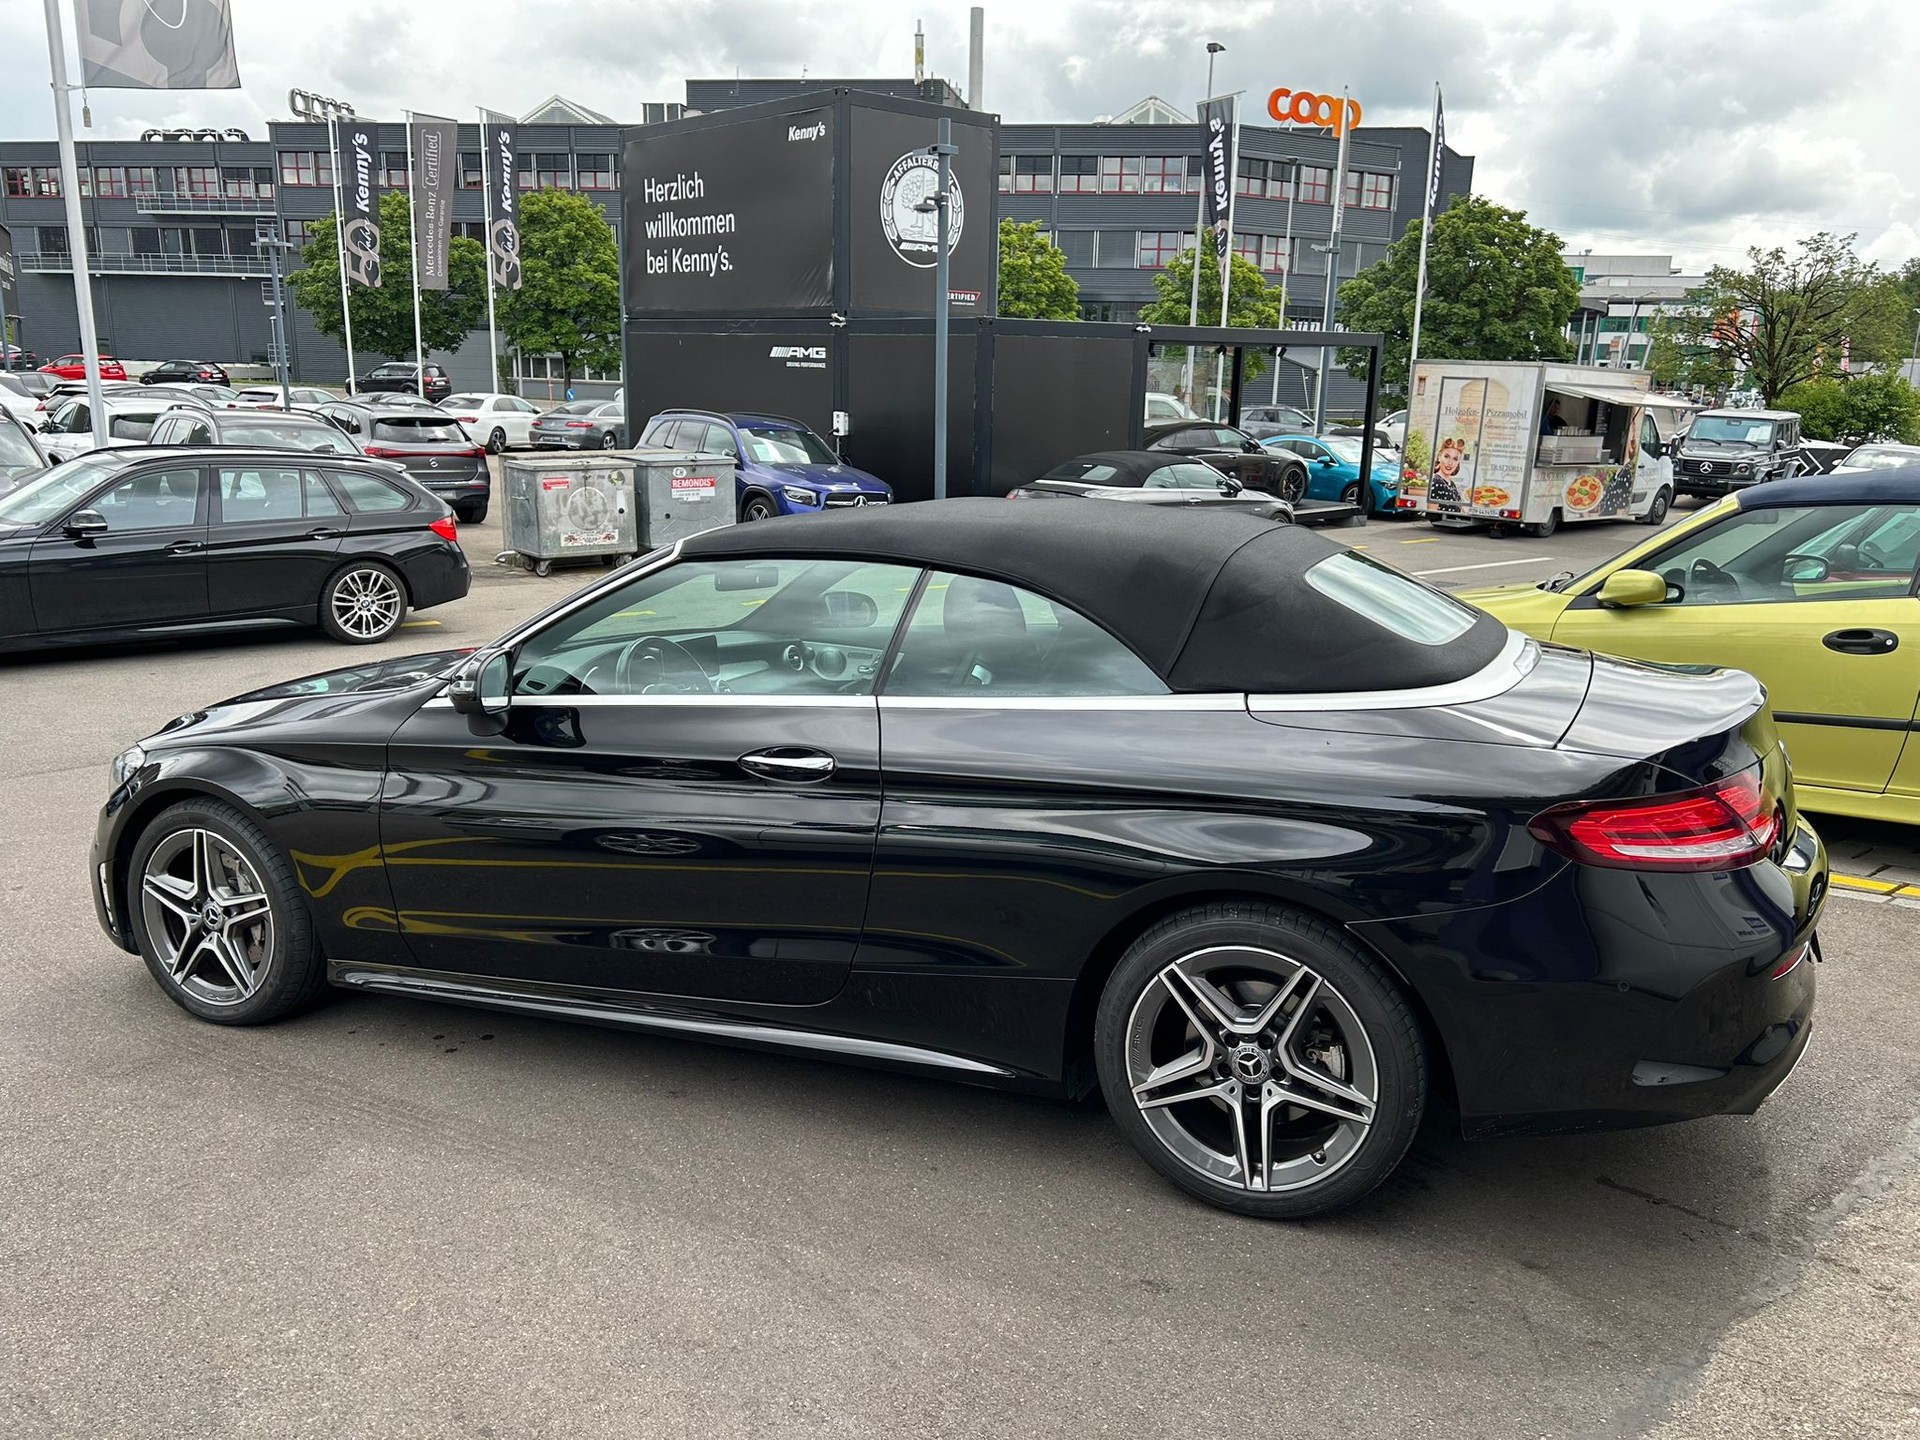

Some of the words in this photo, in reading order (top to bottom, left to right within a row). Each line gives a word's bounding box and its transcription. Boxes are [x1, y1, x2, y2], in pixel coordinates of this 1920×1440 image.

[1267, 87, 1362, 138] coop
[788, 121, 826, 141] Kenny's
[352, 132, 372, 213] Kenny's
[424, 134, 438, 188] Certified
[497, 130, 513, 213] Kenny's
[893, 156, 953, 186] AFFALTERB
[644, 171, 704, 203] Herzlich
[425, 191, 438, 277] Mercedes-Benz
[645, 211, 735, 239] willkommen
[646, 249, 668, 274] bei
[672, 245, 733, 277] Kenny's.
[947, 292, 976, 301] ERTIFIED
[787, 347, 826, 358] AMG
[672, 478, 712, 488] REMONDIS
